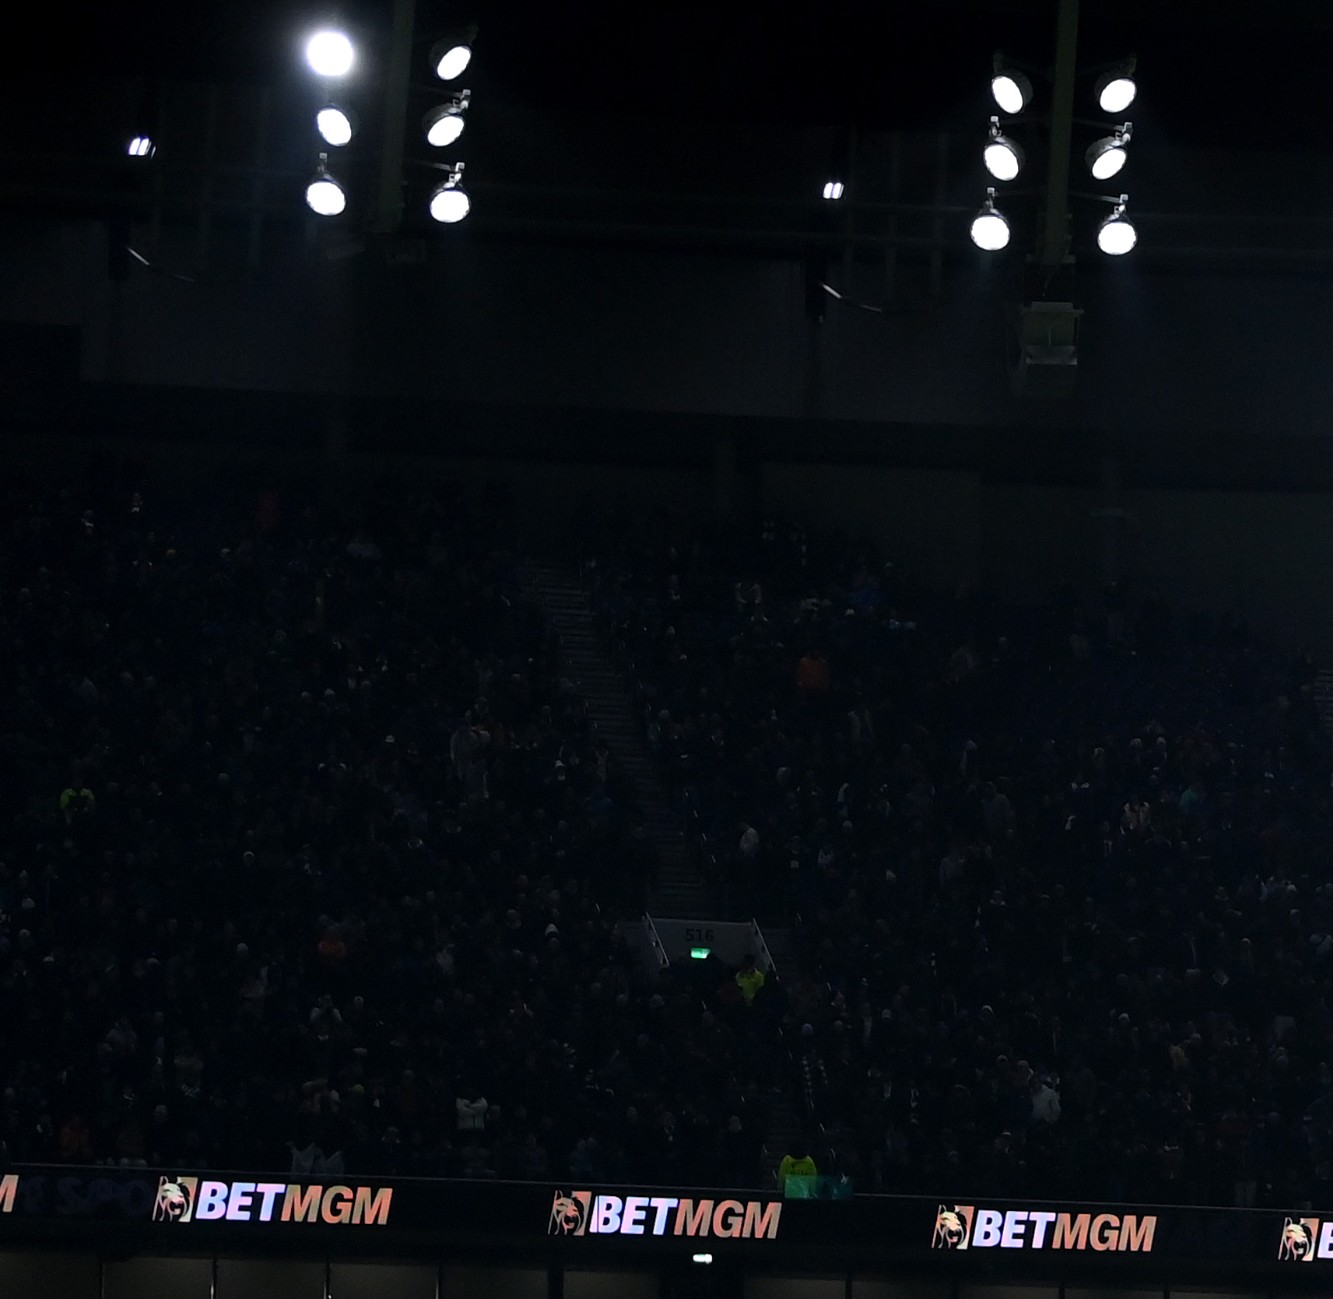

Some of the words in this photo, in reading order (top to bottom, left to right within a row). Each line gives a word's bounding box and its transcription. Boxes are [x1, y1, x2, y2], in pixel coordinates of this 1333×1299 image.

[195, 1177, 392, 1224] BETMGM
[590, 1196, 781, 1238] BETMGM
[972, 1210, 1156, 1251] BETMGM
